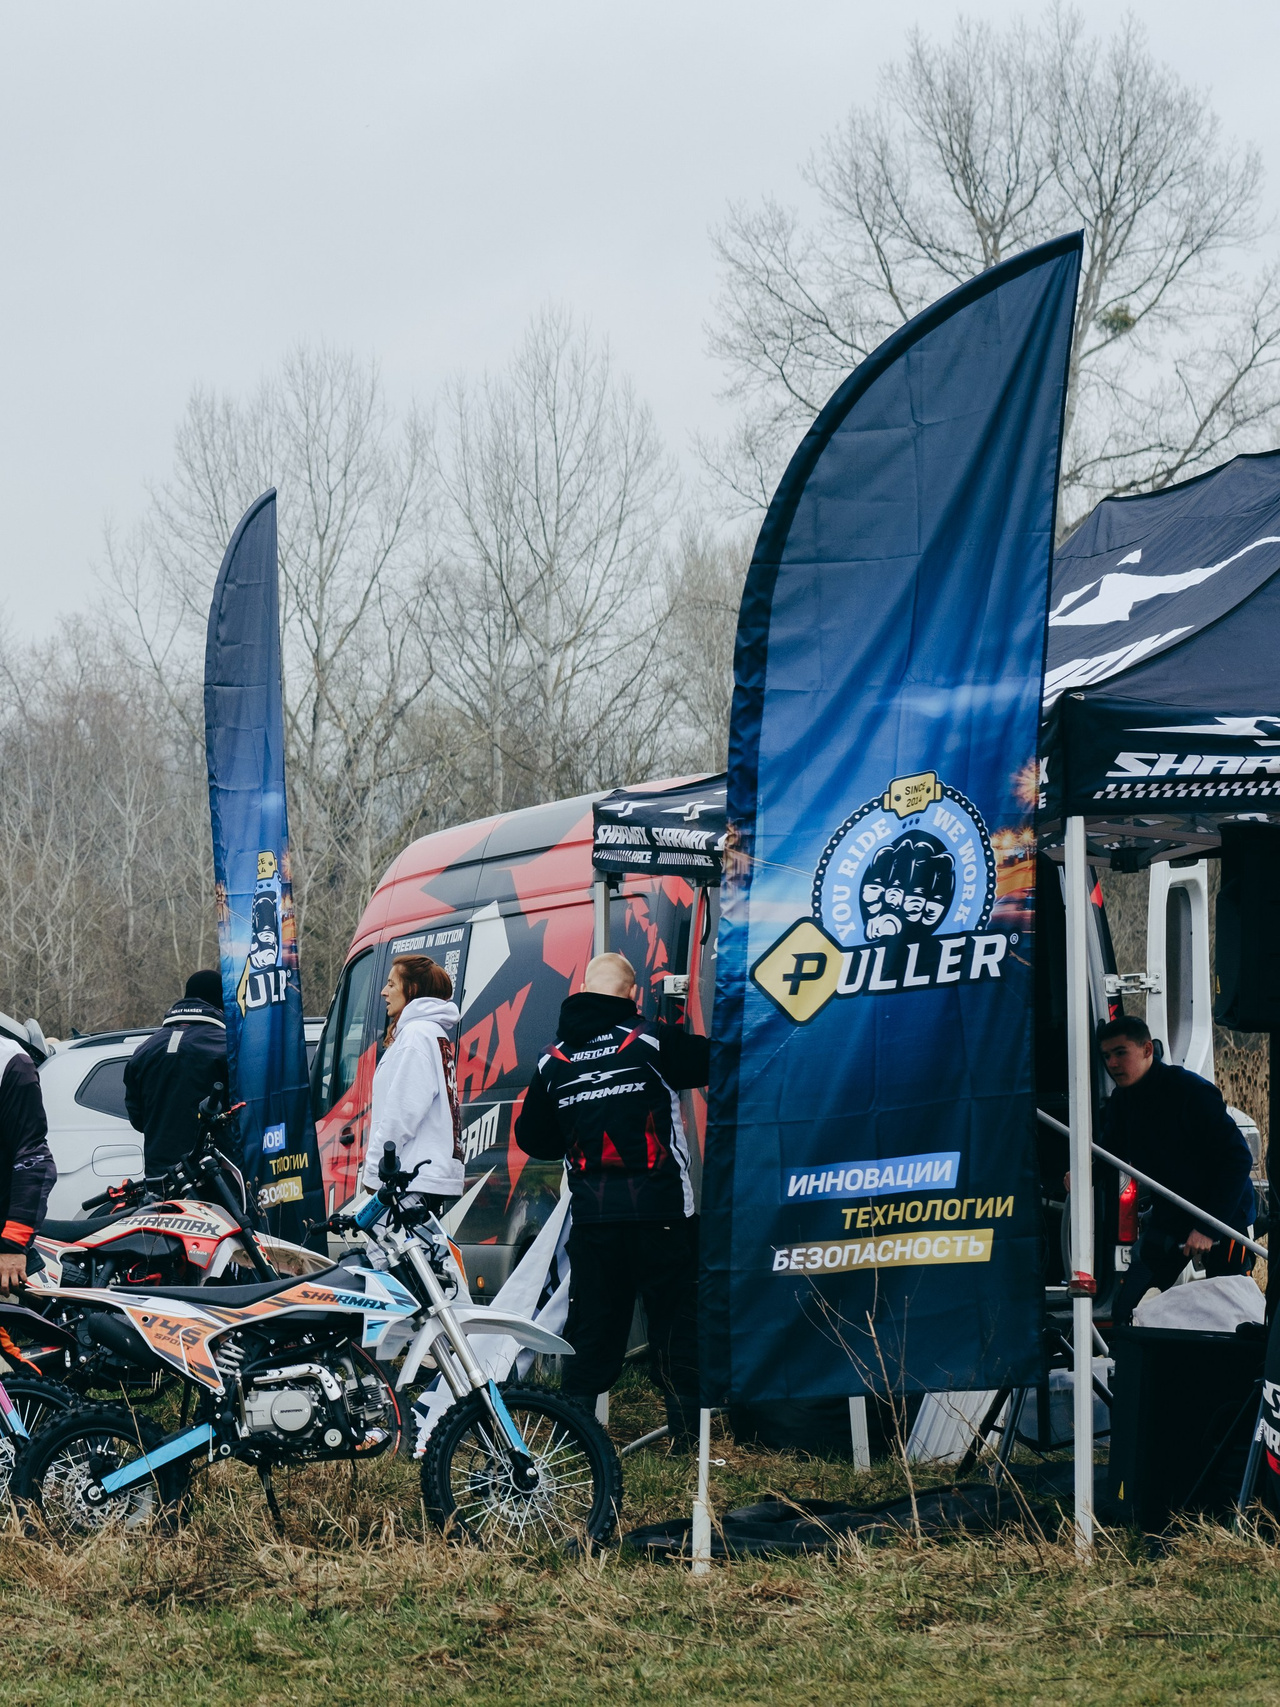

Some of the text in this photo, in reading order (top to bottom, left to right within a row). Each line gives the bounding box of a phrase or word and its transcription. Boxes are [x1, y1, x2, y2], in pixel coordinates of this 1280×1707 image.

[904, 781, 927, 796] SINCE
[906, 796, 923, 808] 2014
[832, 818, 893, 940] YOU RIDE
[933, 807, 977, 925] WE WORK
[391, 928, 465, 954] FREEDOM IN MOTION
[782, 933, 1008, 996] PULLER
[558, 1082, 647, 1109] SHARMAX
[787, 1159, 954, 1197] ИННОВАЦИИ
[116, 1216, 222, 1237] SHARMAX
[841, 1195, 1015, 1230] ТЕХНОЛОГИИ
[772, 1235, 985, 1272] БЕЗОПАСНОСТЬ
[296, 1290, 392, 1311] SHARMAX
[143, 1314, 203, 1348] 145
[154, 1332, 191, 1351] SPORT
